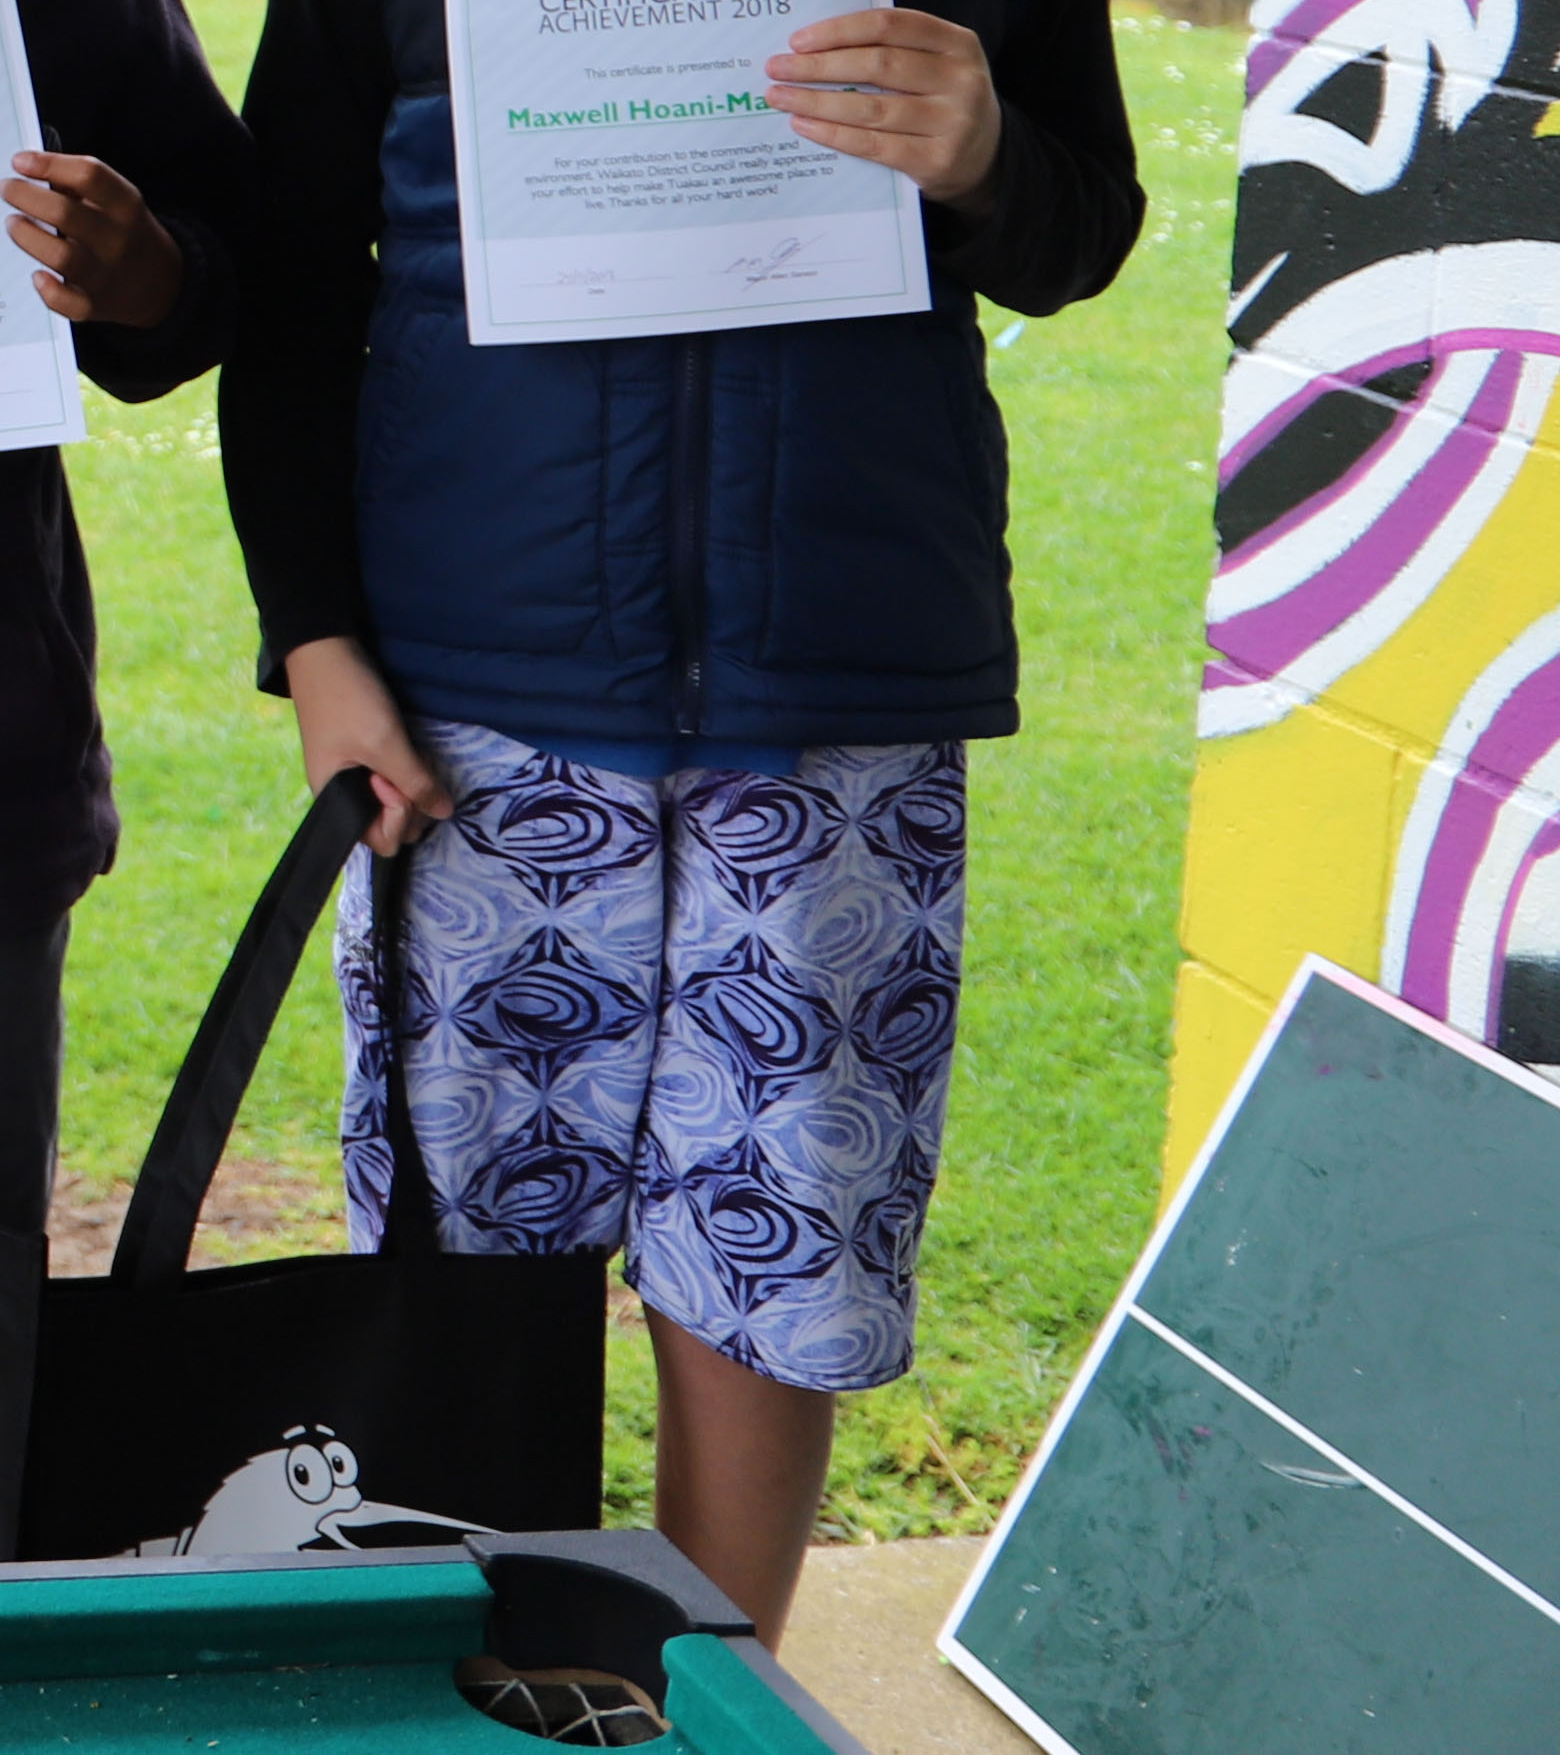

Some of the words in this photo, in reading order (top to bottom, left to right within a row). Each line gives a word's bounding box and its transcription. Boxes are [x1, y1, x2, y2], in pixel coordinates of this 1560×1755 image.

[538, 0, 721, 34] ACHIEVEMENT
[583, 67, 607, 78] This
[609, 65, 663, 77] certificate
[666, 64, 675, 73] is
[677, 58, 735, 74] presented
[737, 58, 752, 67] to
[508, 102, 618, 128] Maxwell
